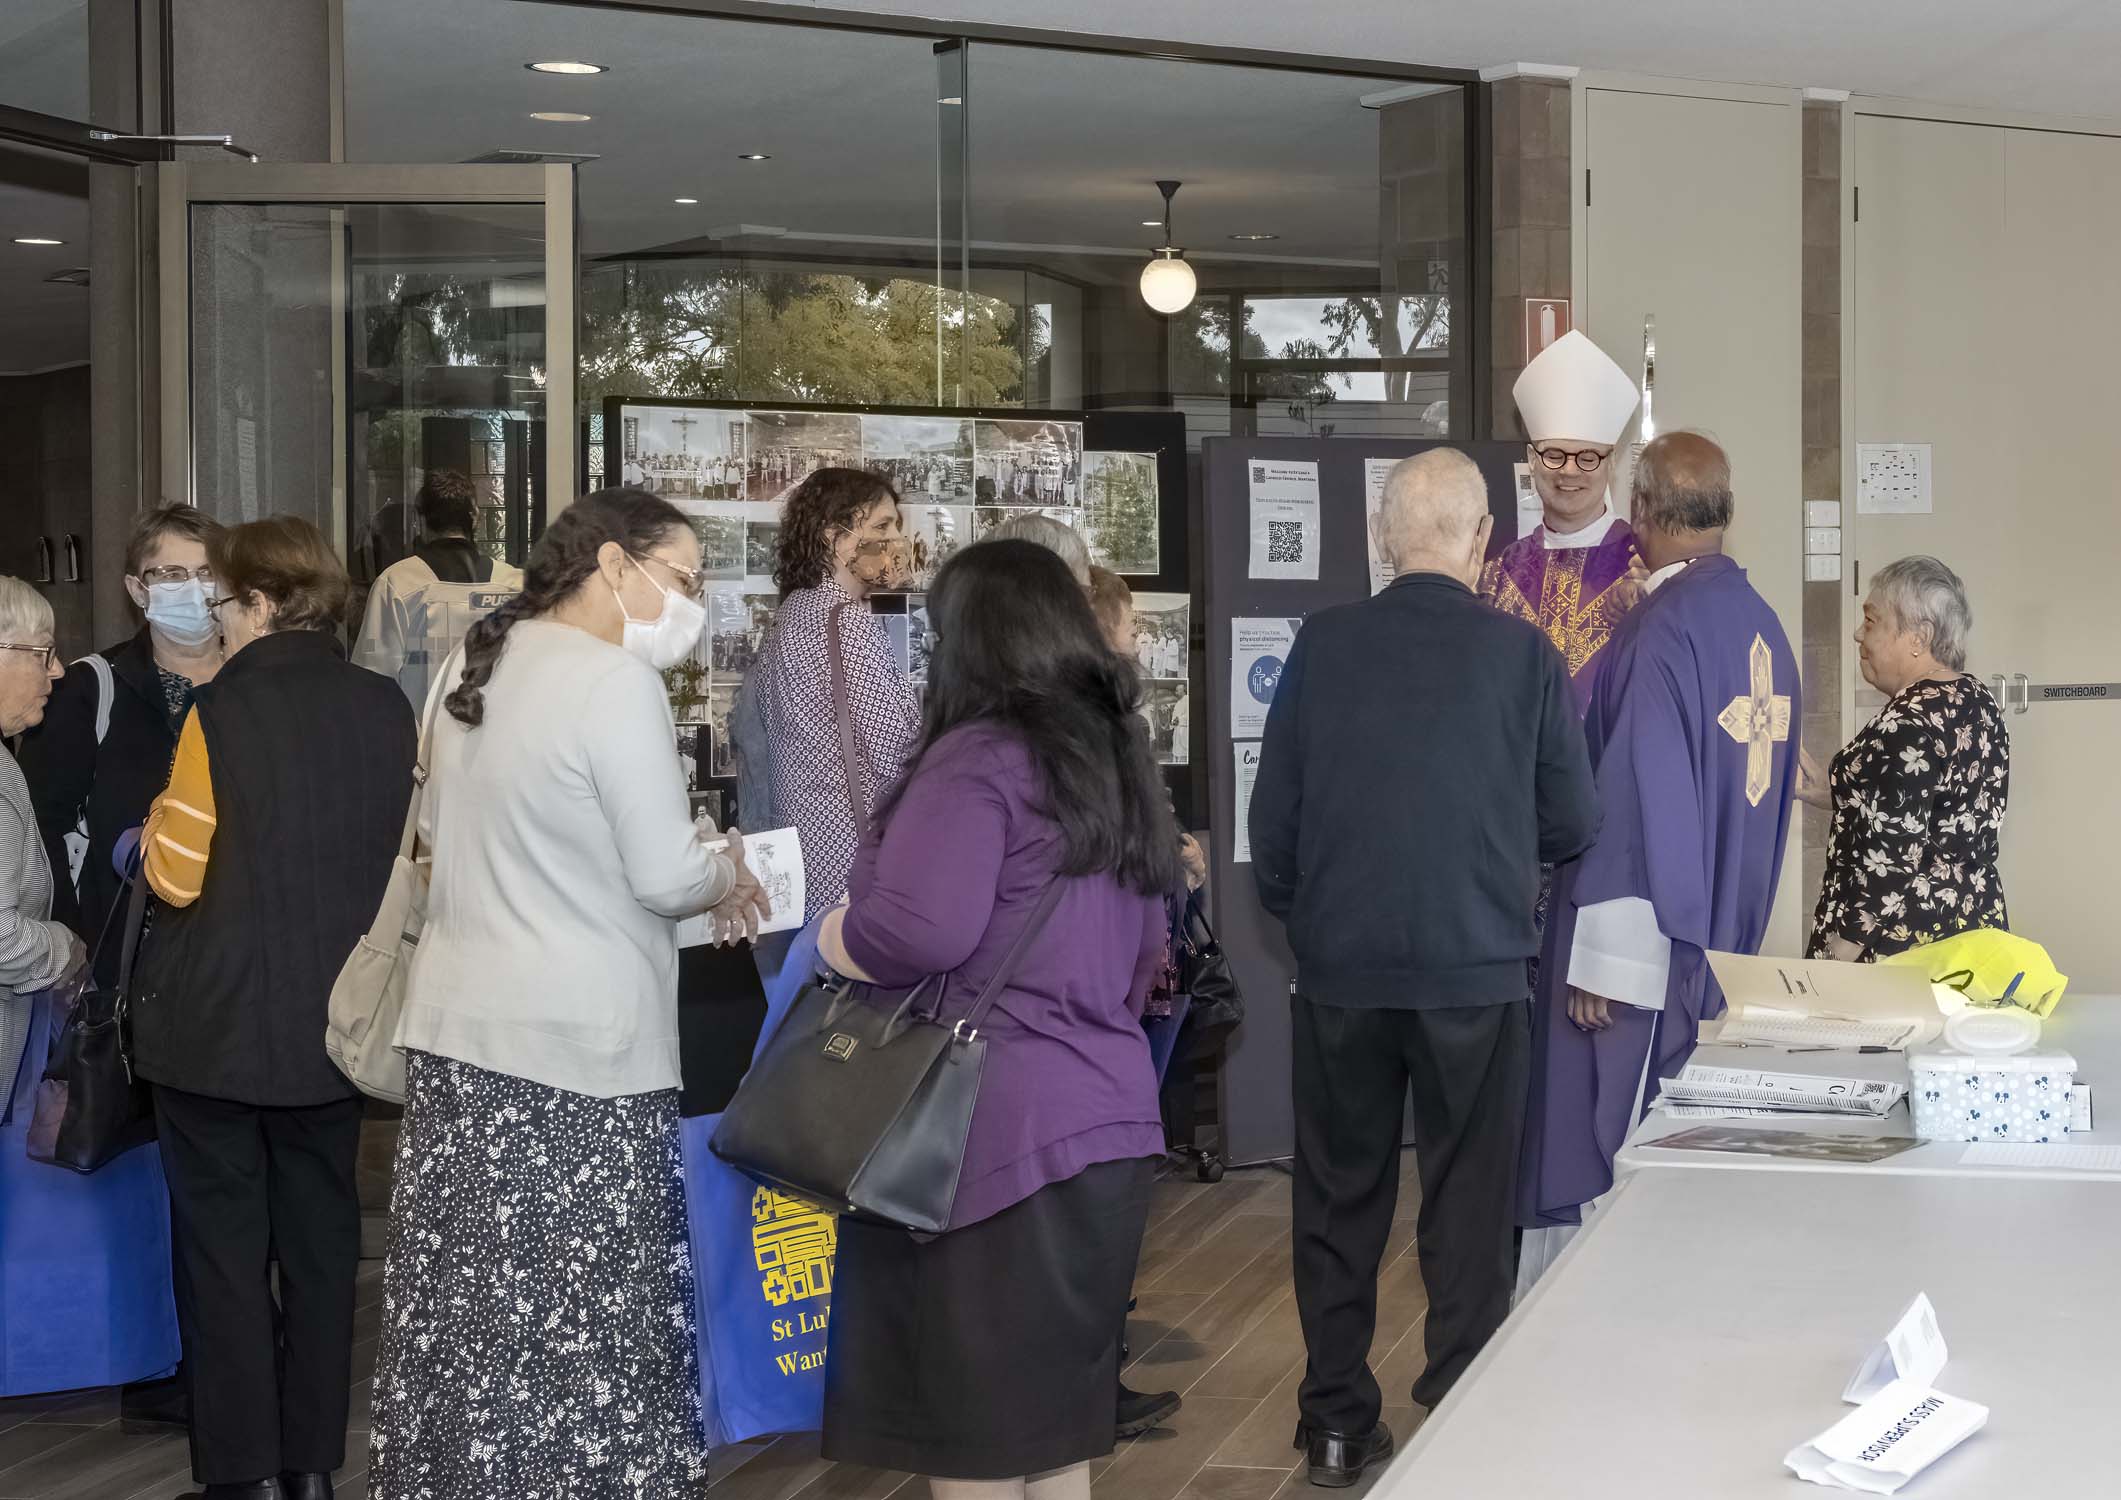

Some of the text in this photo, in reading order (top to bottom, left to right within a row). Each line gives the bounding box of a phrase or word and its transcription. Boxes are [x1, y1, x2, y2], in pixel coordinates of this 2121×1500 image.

[481, 594, 512, 607] PUS
[2044, 686, 2107, 698] SWITCHBOARD
[771, 1319, 794, 1342] St
[1856, 1396, 1945, 1462] MASS SUPERVISOR
